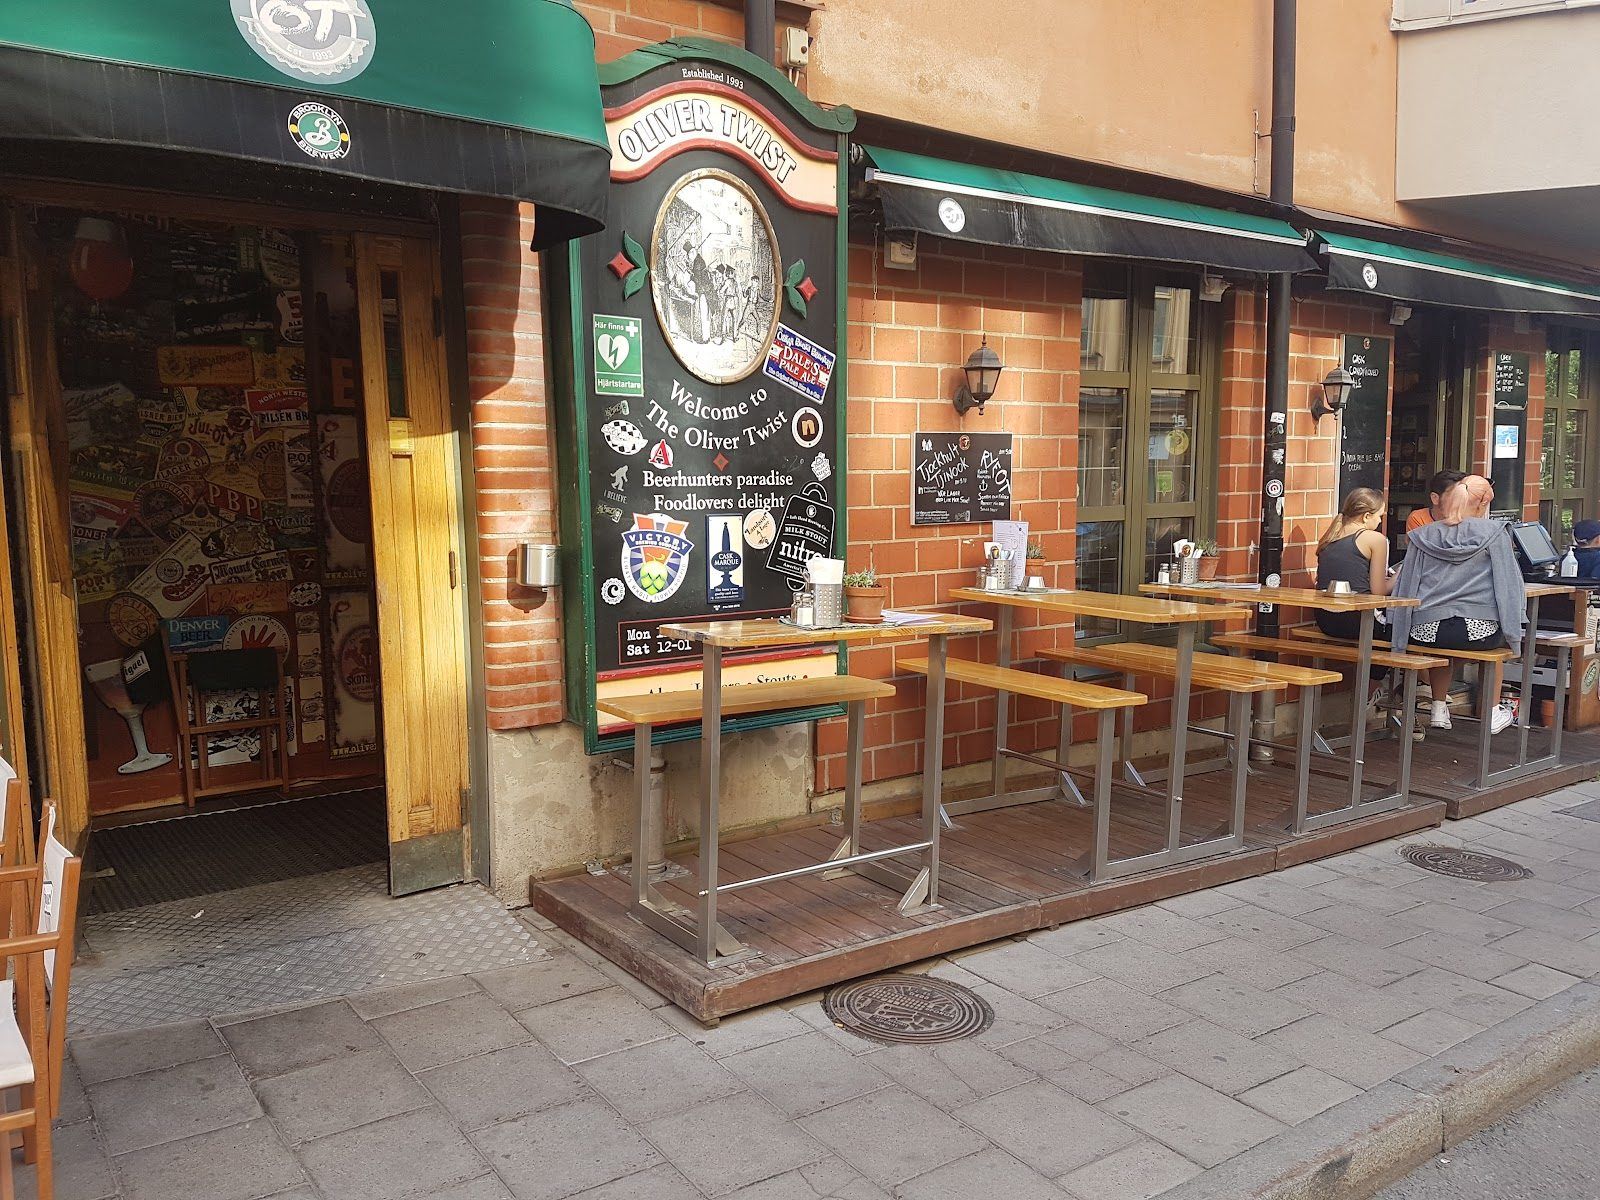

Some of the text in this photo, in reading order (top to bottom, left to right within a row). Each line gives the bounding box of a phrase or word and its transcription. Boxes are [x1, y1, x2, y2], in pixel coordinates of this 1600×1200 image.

[312, 49, 334, 60] 1993
[682, 67, 744, 90] Established 1993
[293, 104, 342, 127] BROOKLYN
[618, 98, 797, 183] OLIVER TWIST
[298, 139, 346, 161] BREWERY
[594, 321, 624, 331] Här finns
[783, 345, 820, 376] DALE'S
[779, 359, 817, 386] PALE ALE
[597, 379, 641, 390] Hjärtstartare
[670, 380, 768, 421] Welcome to
[261, 411, 293, 423] PILSEN
[645, 399, 679, 439] The
[684, 427, 740, 451] Oliver
[742, 409, 788, 447] Twist
[160, 462, 192, 480] LAGER
[643, 470, 794, 489] Beerhunters paradise
[654, 493, 786, 515] Foodlovers delight
[73, 525, 108, 540] ONER
[628, 533, 688, 550] VICTORY
[785, 526, 828, 545] MILK STOUT
[714, 558, 739, 566] MARQUE
[169, 619, 220, 633] DENVER
[627, 629, 652, 641] Mon
[181, 630, 210, 642] BEER
[627, 639, 692, 657] Sat 12-01
